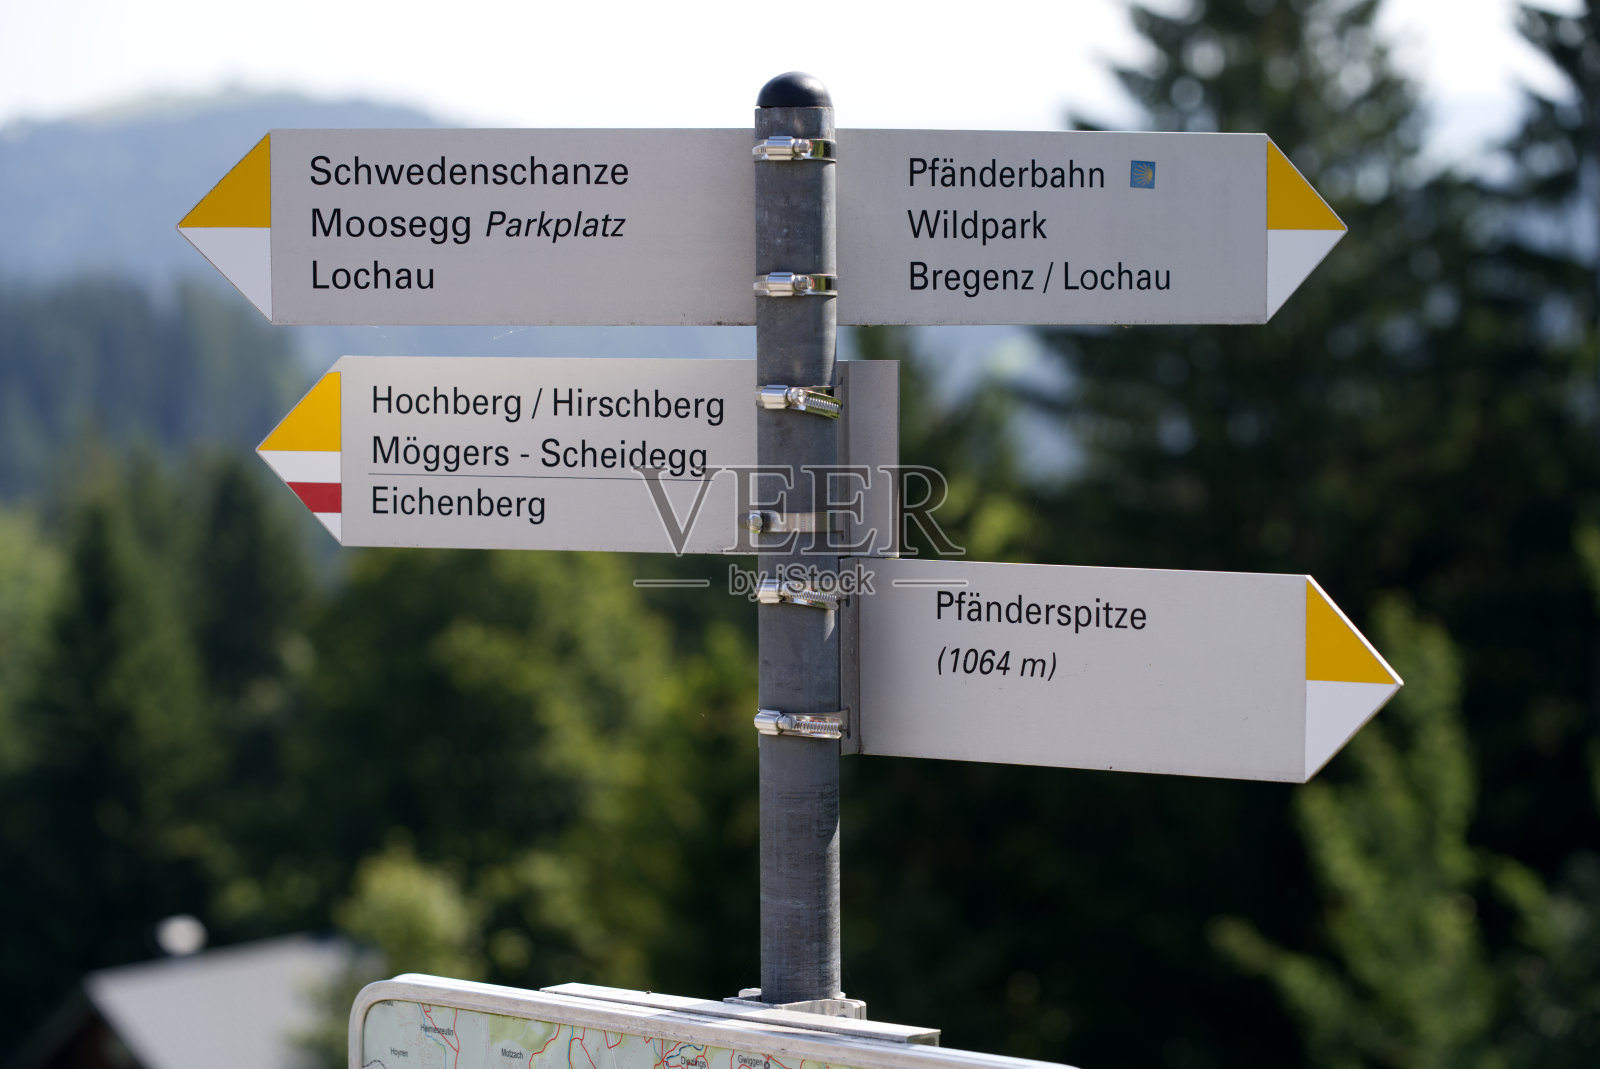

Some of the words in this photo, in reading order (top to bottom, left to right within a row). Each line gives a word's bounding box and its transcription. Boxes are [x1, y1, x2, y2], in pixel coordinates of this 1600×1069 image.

[310, 155, 629, 186] Schwedenschanze
[909, 157, 1105, 189] Pfänderbahn
[311, 207, 471, 245] Moosegg
[485, 210, 627, 244] Parkplatz
[908, 209, 1048, 247] Wildpark
[312, 260, 434, 290] Lochau
[909, 261, 1035, 298] Bregenz
[1042, 261, 1054, 294] /
[1064, 261, 1171, 291] Lochau
[373, 385, 521, 423] Hochberg
[531, 387, 543, 420] /
[553, 387, 724, 427] Hirschberg
[373, 435, 510, 473] Möggers
[541, 438, 707, 478] Scheidegg
[372, 485, 545, 525] Eichenberg
[936, 590, 1147, 634] Pfänderspitze
[937, 646, 1011, 676] (1064
[1020, 651, 1057, 682] m)
[737, 1054, 764, 1068] Gwiggen
